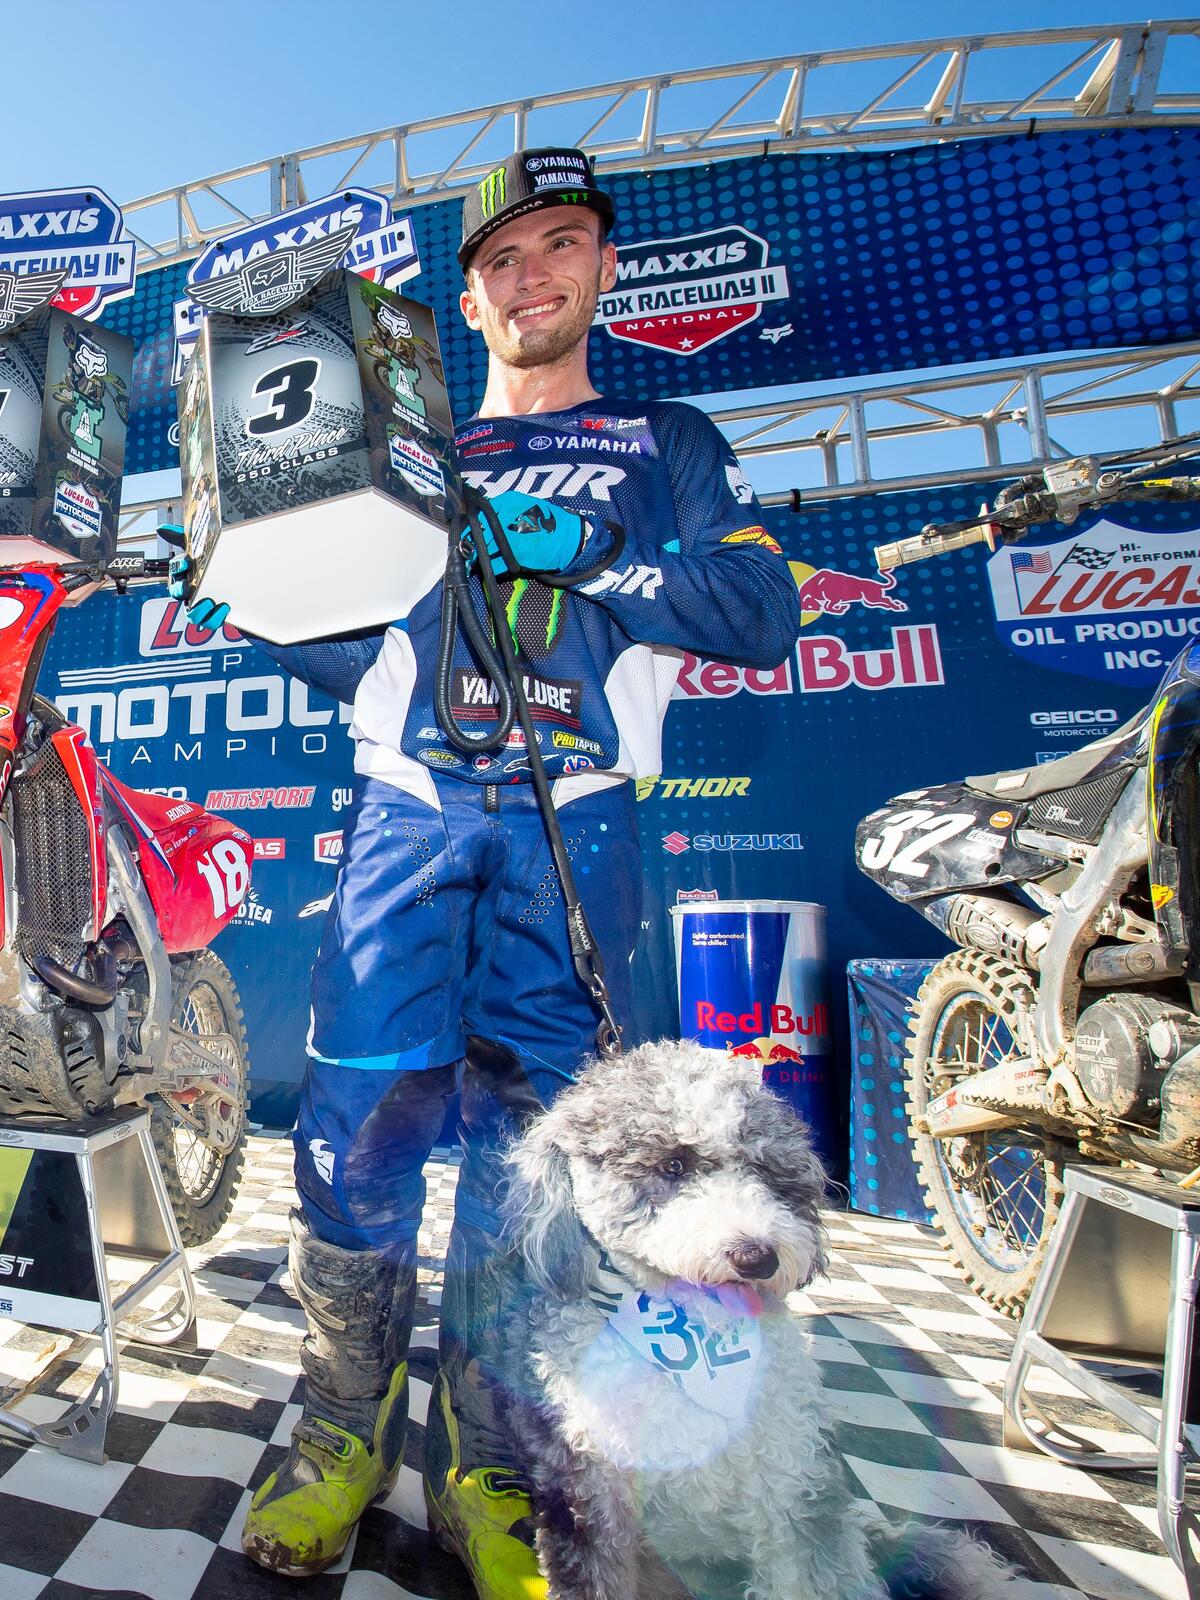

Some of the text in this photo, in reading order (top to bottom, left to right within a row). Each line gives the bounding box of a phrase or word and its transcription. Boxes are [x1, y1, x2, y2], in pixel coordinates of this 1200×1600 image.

[541, 155, 586, 171] YAMAHA
[535, 171, 585, 186] YAMALUBE
[210, 203, 364, 278] MAXXIS
[616, 241, 747, 281] MAXXIS
[260, 283, 299, 301] RACEWAY
[638, 277, 756, 312] RACEWAY
[761, 274, 775, 294] II
[626, 309, 743, 331] NATIONAL
[247, 357, 323, 437] 3
[233, 427, 350, 473] Third Place
[555, 436, 642, 454] YAMAHA
[237, 448, 339, 483] 250 CLASS
[1119, 543, 1142, 552] HI-
[1011, 628, 1066, 647] OIL
[800, 626, 942, 690] Bull
[1104, 650, 1171, 670] INC.
[462, 676, 572, 714] YAMLUBE
[1030, 709, 1119, 725] GEICO
[1044, 728, 1109, 738] MOTORCYCLE
[661, 777, 751, 798] THOR
[165, 803, 194, 822] HONDA
[693, 834, 801, 850] SUZUKI
[860, 809, 977, 878] 32
[196, 839, 248, 920] 18
[249, 902, 273, 925] TEA
[696, 1002, 827, 1036] Red Bull
